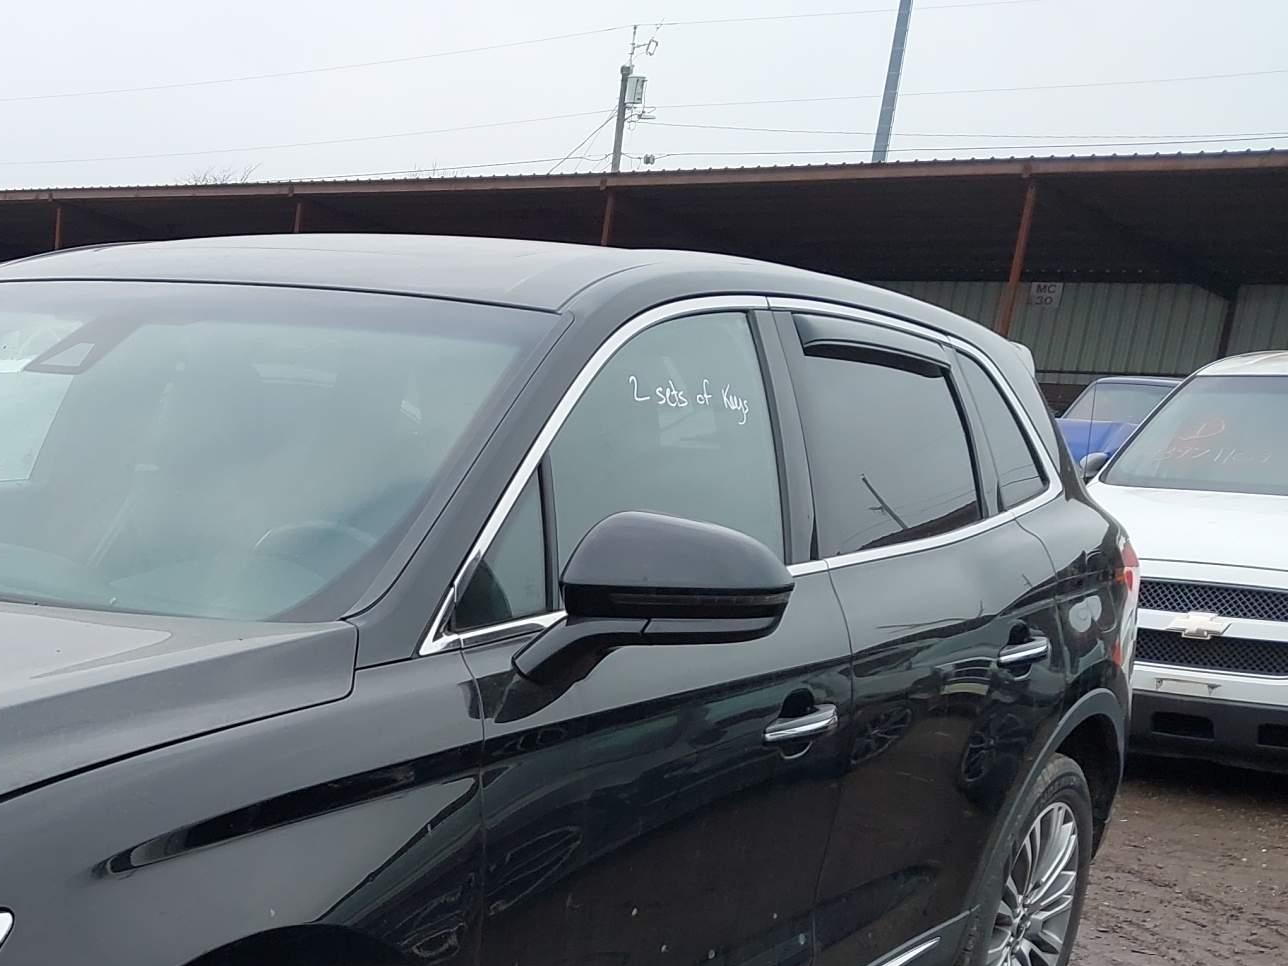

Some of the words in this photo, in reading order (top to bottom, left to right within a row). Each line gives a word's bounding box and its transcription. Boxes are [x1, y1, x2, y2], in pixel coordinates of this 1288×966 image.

[1036, 284, 1057, 294] MC
[1035, 296, 1053, 305] 30
[629, 375, 650, 401] 2
[656, 380, 688, 407] sets
[696, 379, 712, 406] of
